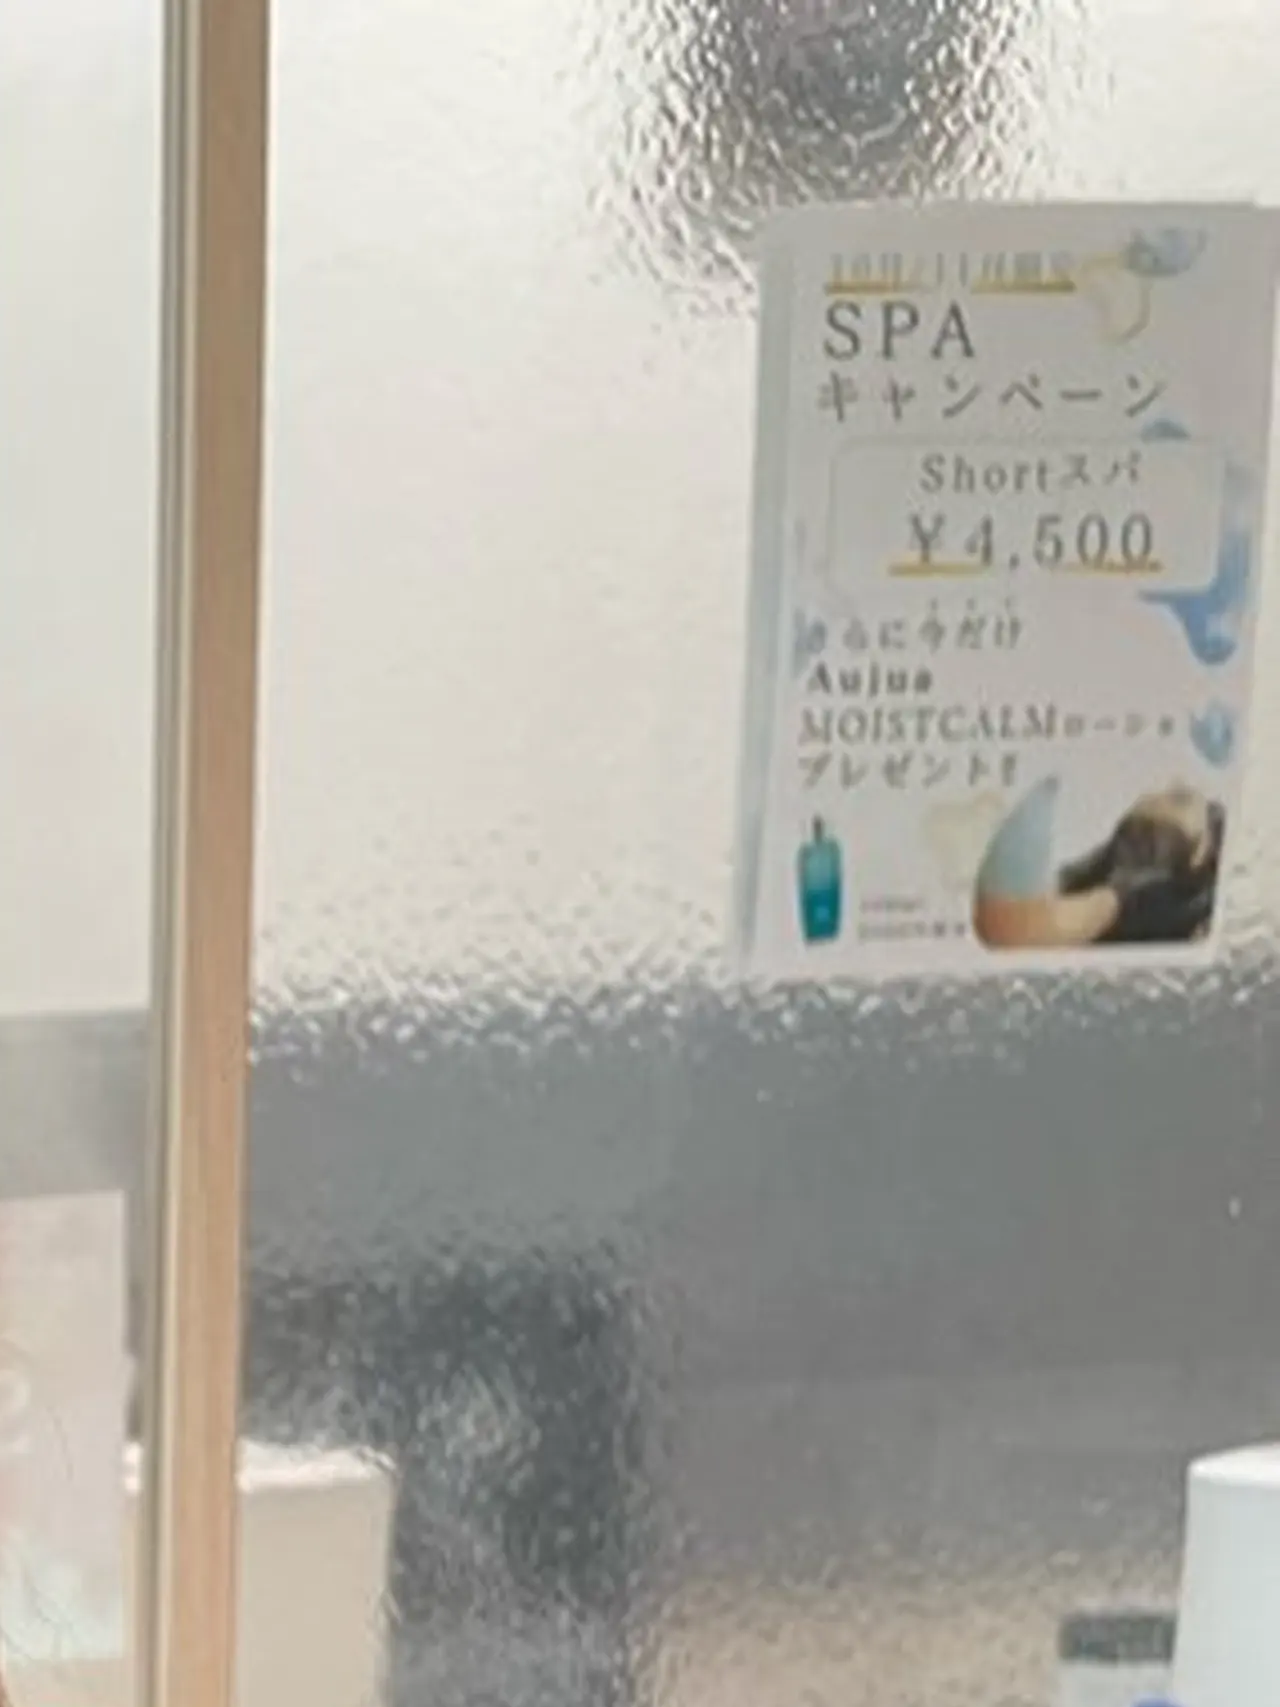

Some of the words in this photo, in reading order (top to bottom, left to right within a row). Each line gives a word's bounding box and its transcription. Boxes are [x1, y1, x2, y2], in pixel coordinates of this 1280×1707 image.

[823, 300, 976, 361] SPA
[817, 369, 1169, 424] キャンペーン
